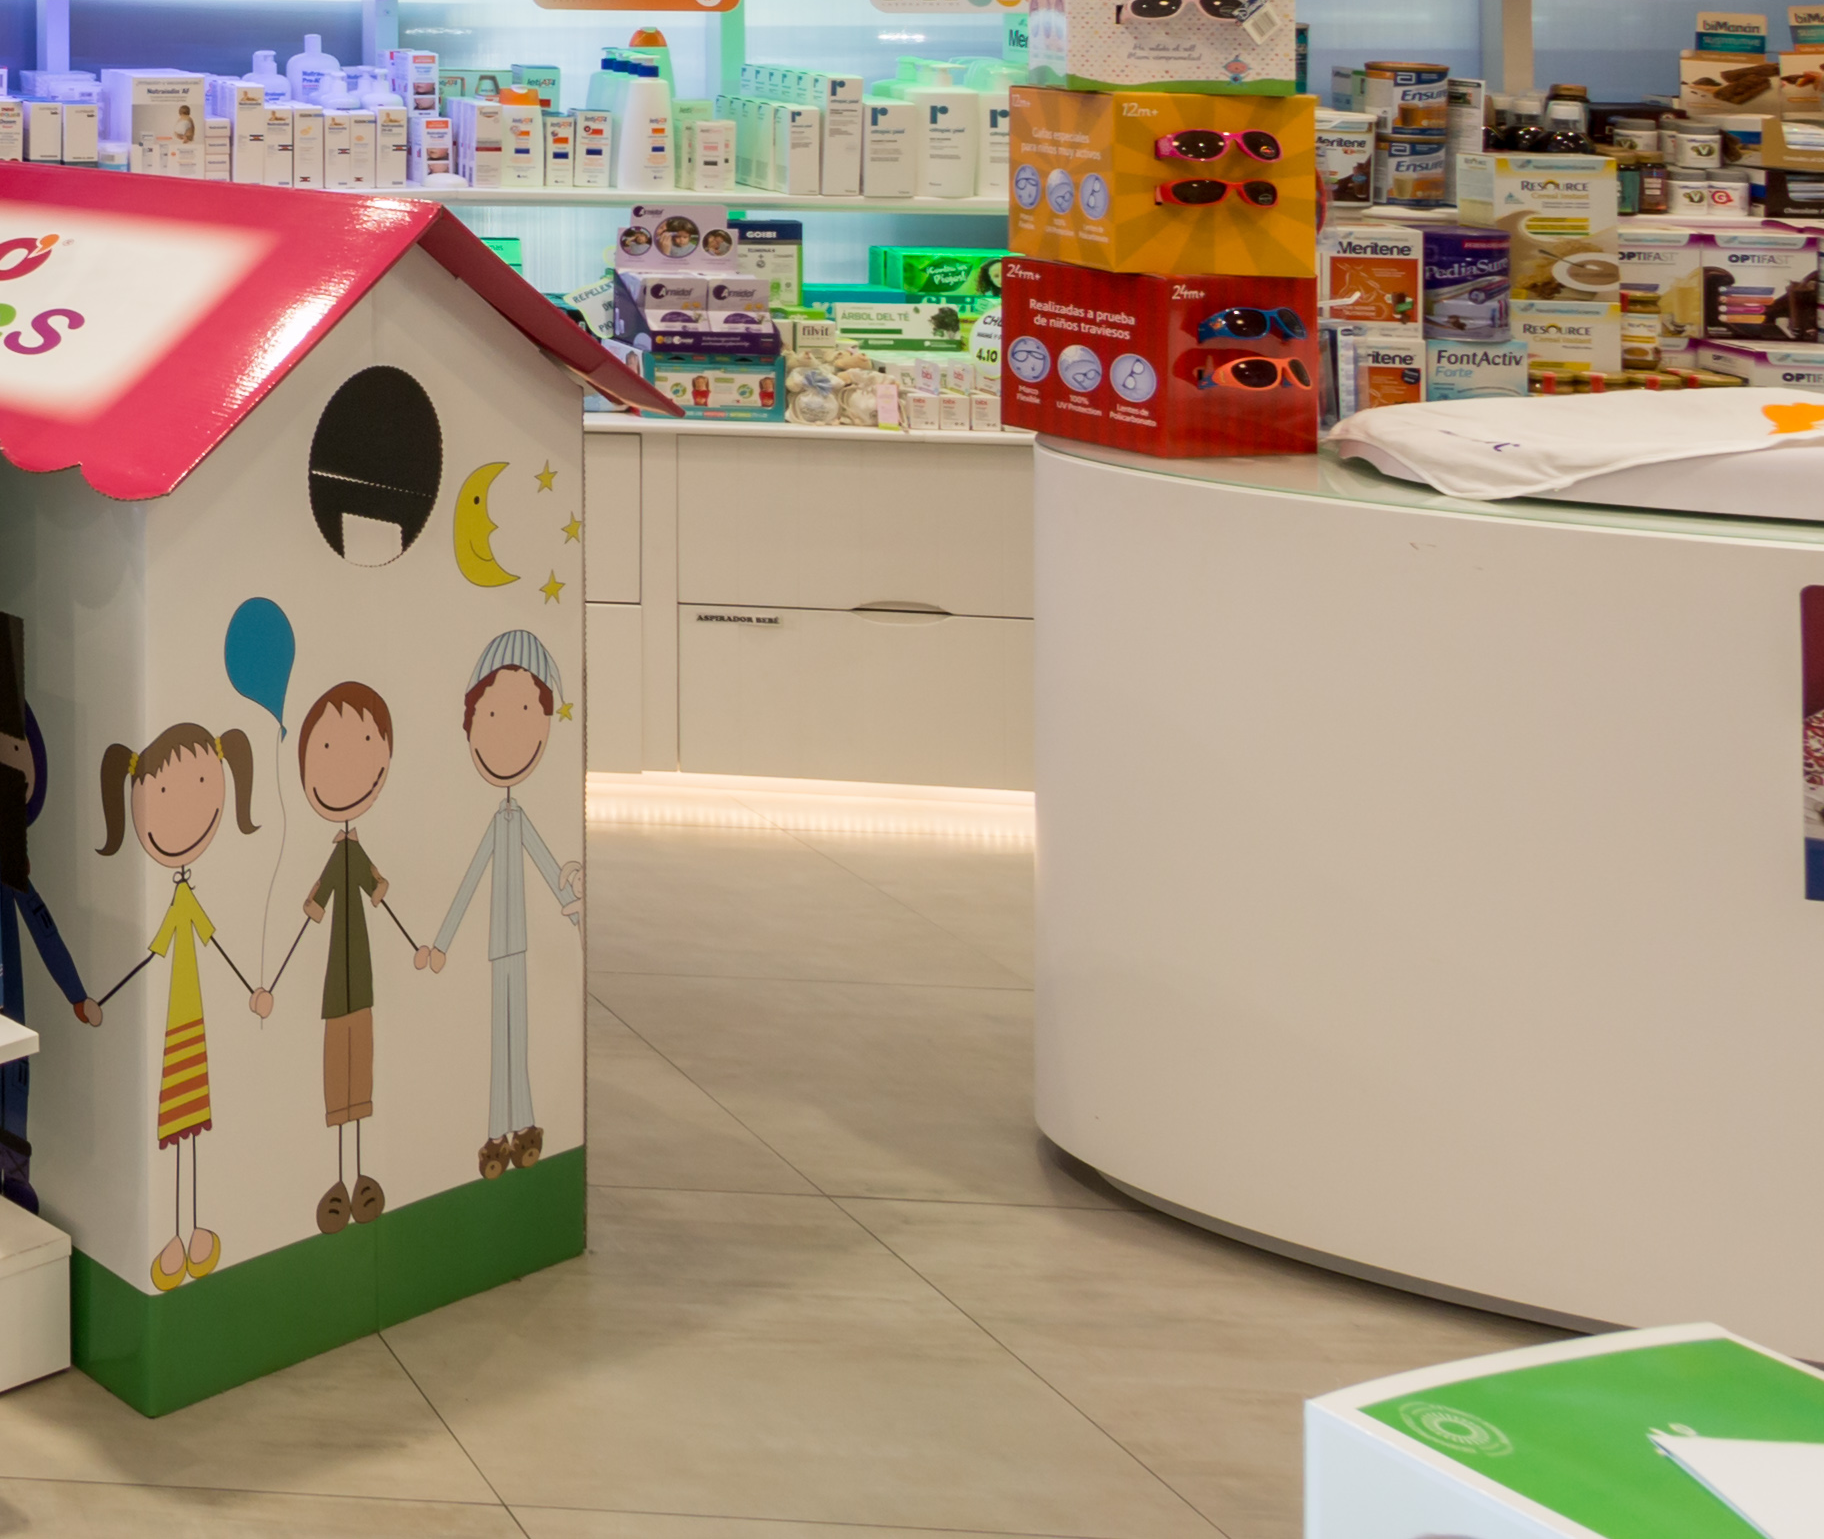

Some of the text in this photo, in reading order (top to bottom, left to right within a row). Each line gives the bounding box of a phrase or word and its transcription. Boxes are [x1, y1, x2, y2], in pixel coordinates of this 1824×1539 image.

[1030, 299, 1084, 319] Realizadas
[1096, 310, 1135, 327] prueba
[1034, 314, 1130, 340] de niños traviesos
[1436, 348, 1523, 371] FontActiv
